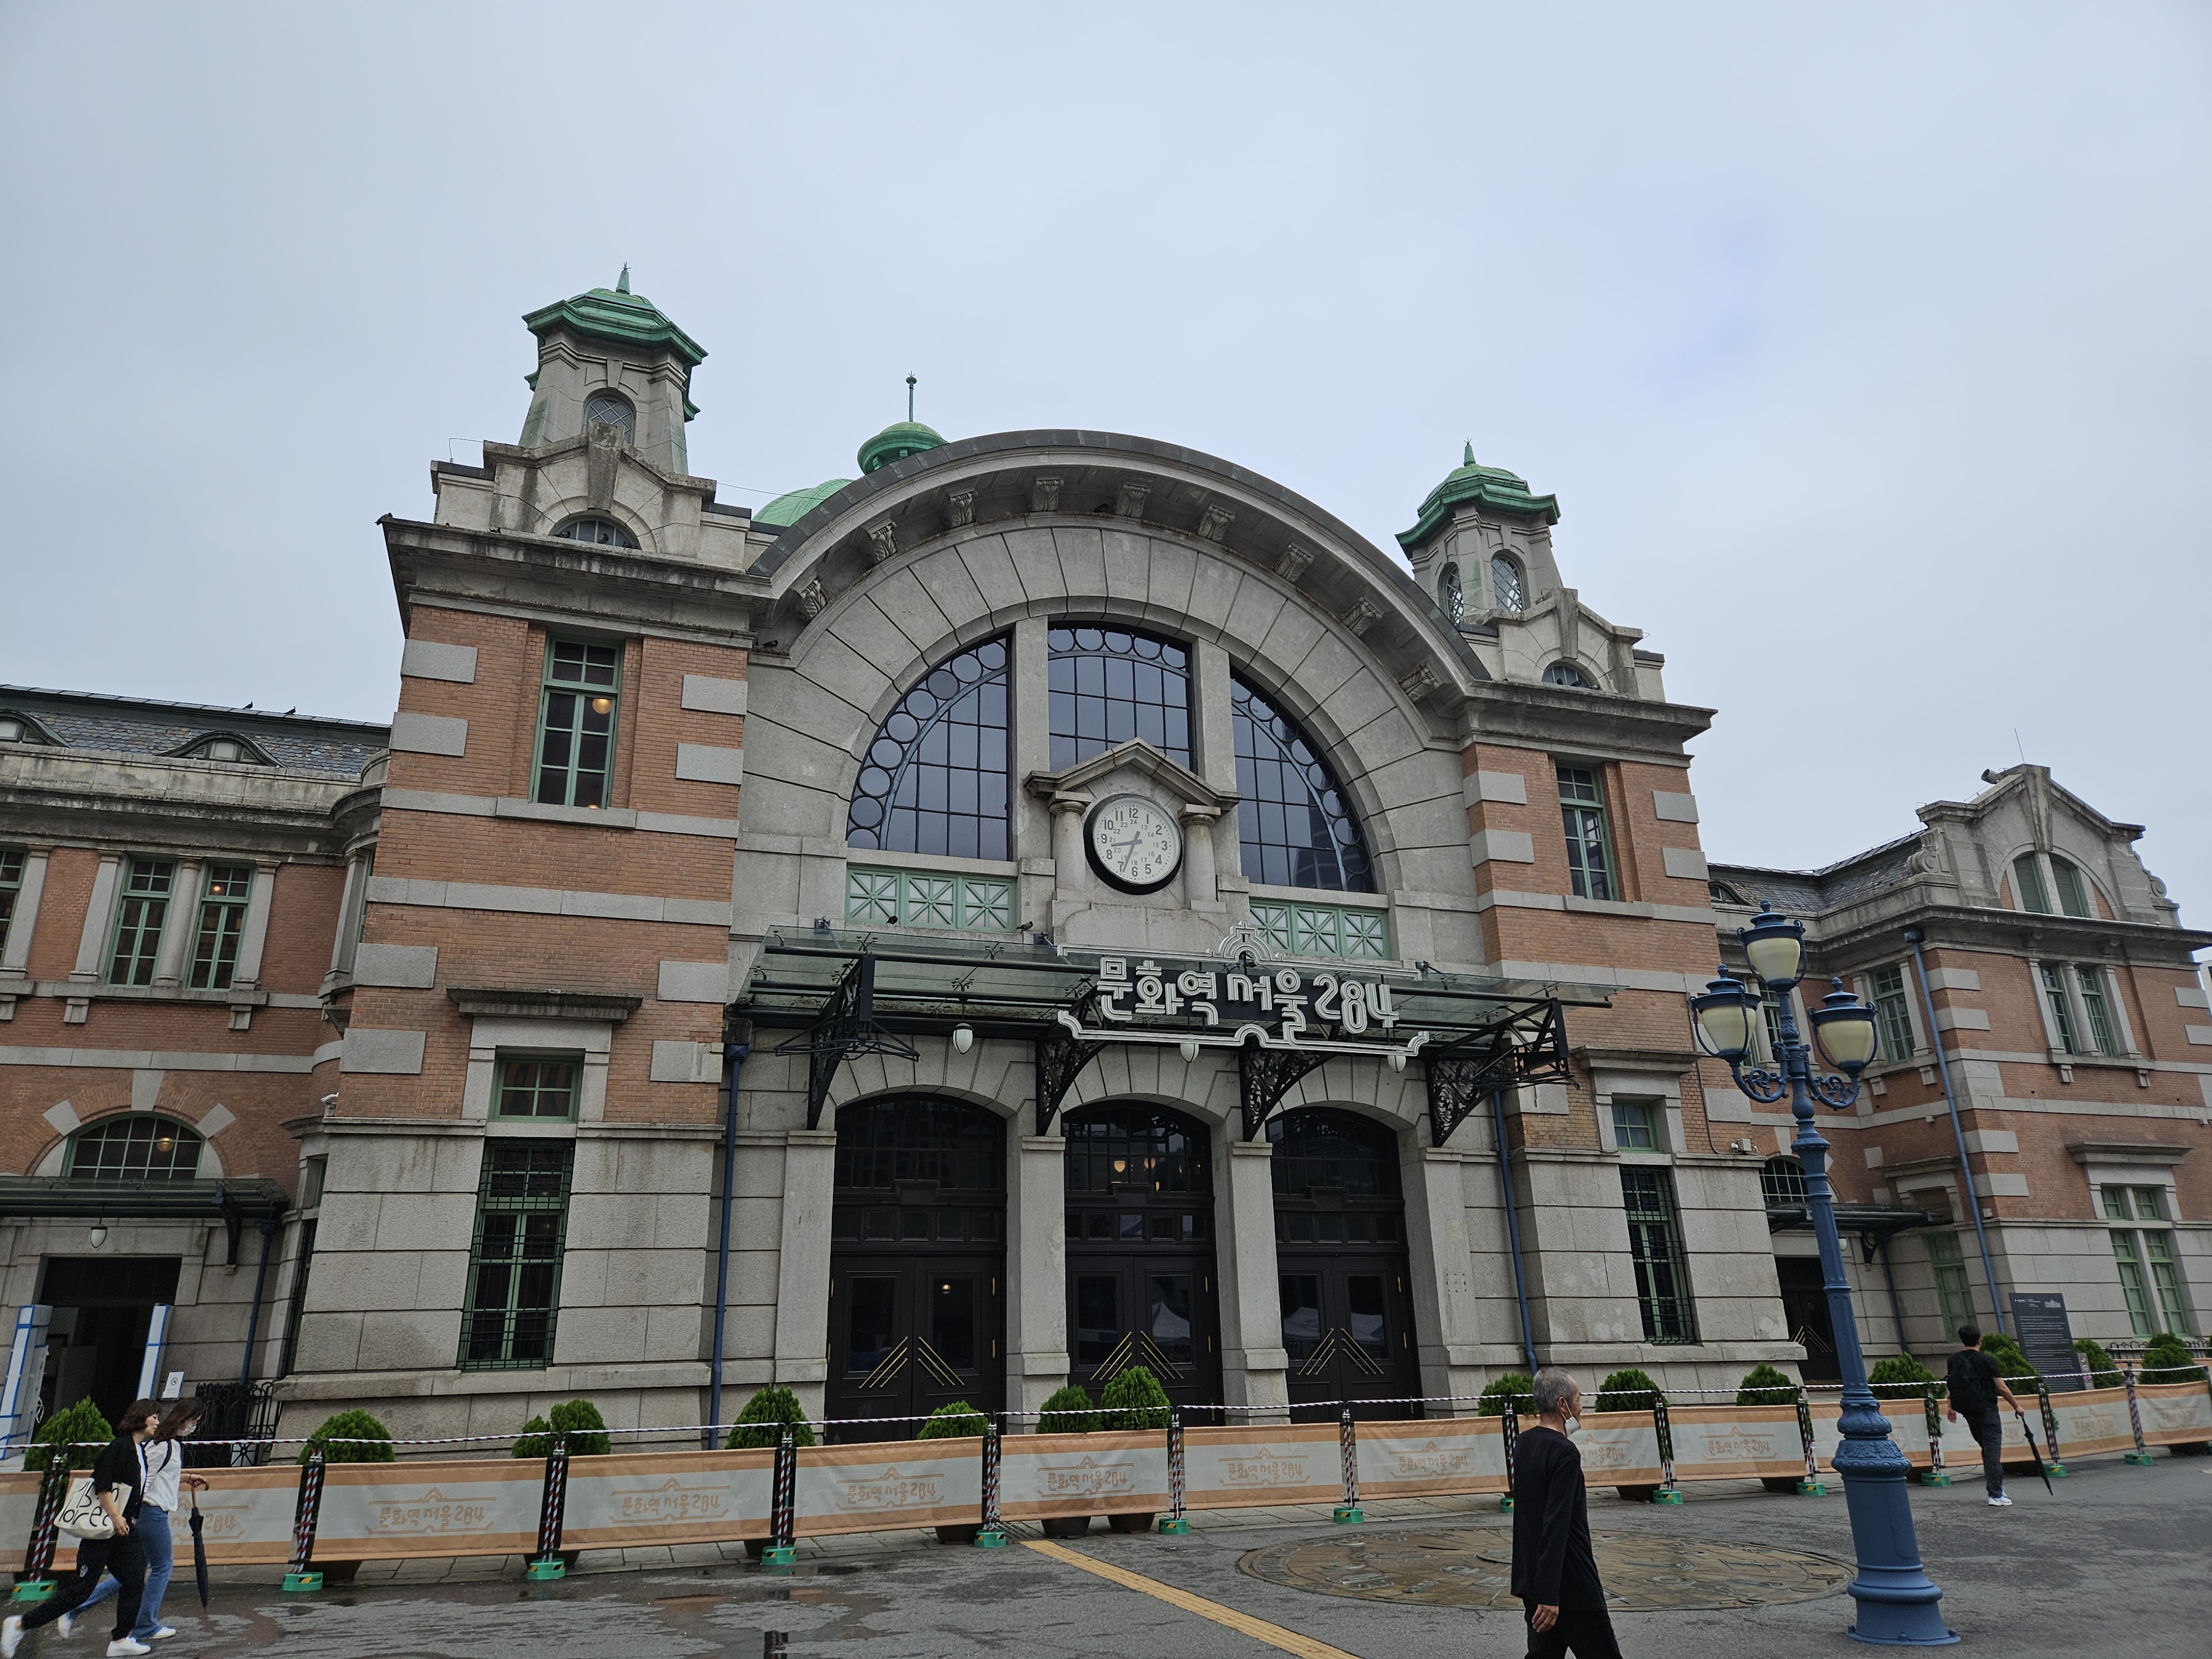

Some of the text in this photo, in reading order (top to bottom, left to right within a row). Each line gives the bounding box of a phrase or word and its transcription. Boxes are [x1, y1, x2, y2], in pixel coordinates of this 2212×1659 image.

[1115, 810, 1123, 821] 11
[1129, 807, 1138, 818] 12
[1104, 819, 1114, 830] 10
[1156, 825, 1162, 835] 2
[1101, 833, 1107, 844] 9
[1161, 841, 1167, 851] 3
[1106, 849, 1113, 859] 8
[1155, 854, 1162, 865] 4
[1118, 860, 1124, 872] 7
[1145, 864, 1151, 874] 5
[1131, 867, 1138, 877] 6
[1313, 973, 1400, 1034] 284
[1104, 1471, 1127, 1488] 284
[911, 1482, 936, 1500] 284
[455, 1505, 485, 1525] 284
[204, 1514, 236, 1533] 284
